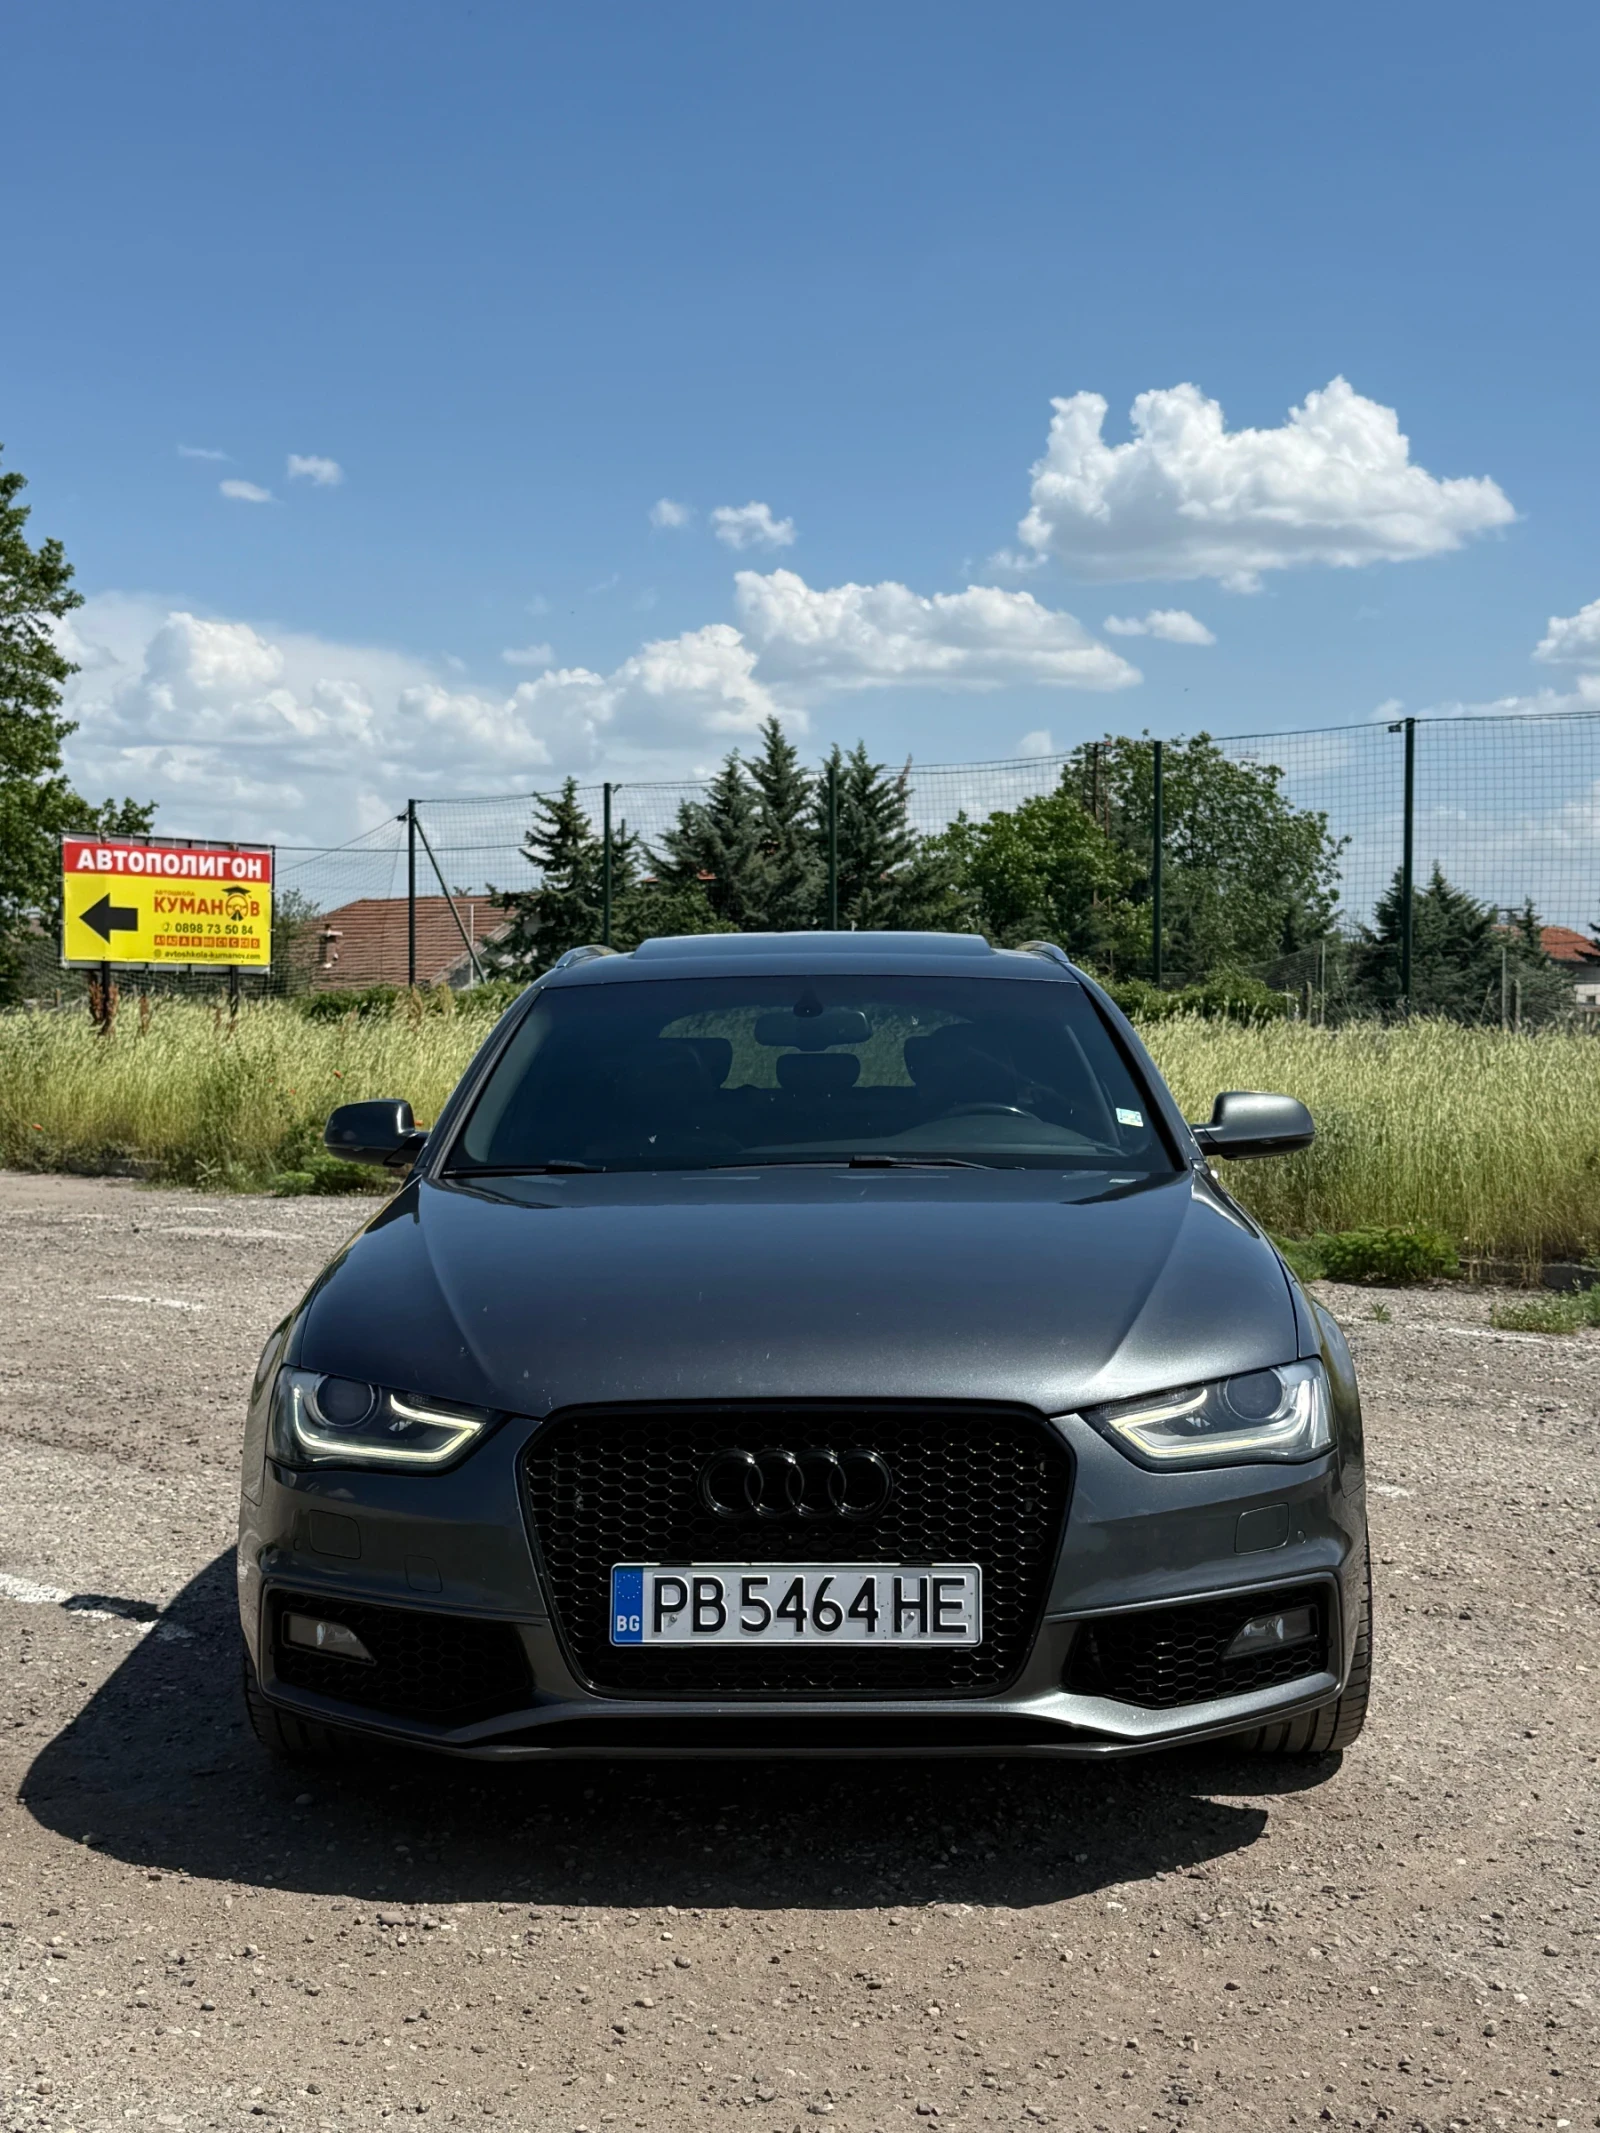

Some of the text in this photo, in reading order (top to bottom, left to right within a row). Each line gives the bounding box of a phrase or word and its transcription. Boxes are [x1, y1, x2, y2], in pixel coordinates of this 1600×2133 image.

[76, 849, 262, 879] АВТОПОЛИГОН
[175, 922, 254, 935] 0898 73 50 84
[164, 950, 261, 960] avtoshkola-kumanov.com
[616, 1576, 968, 1634] BG PB 5464 HE
